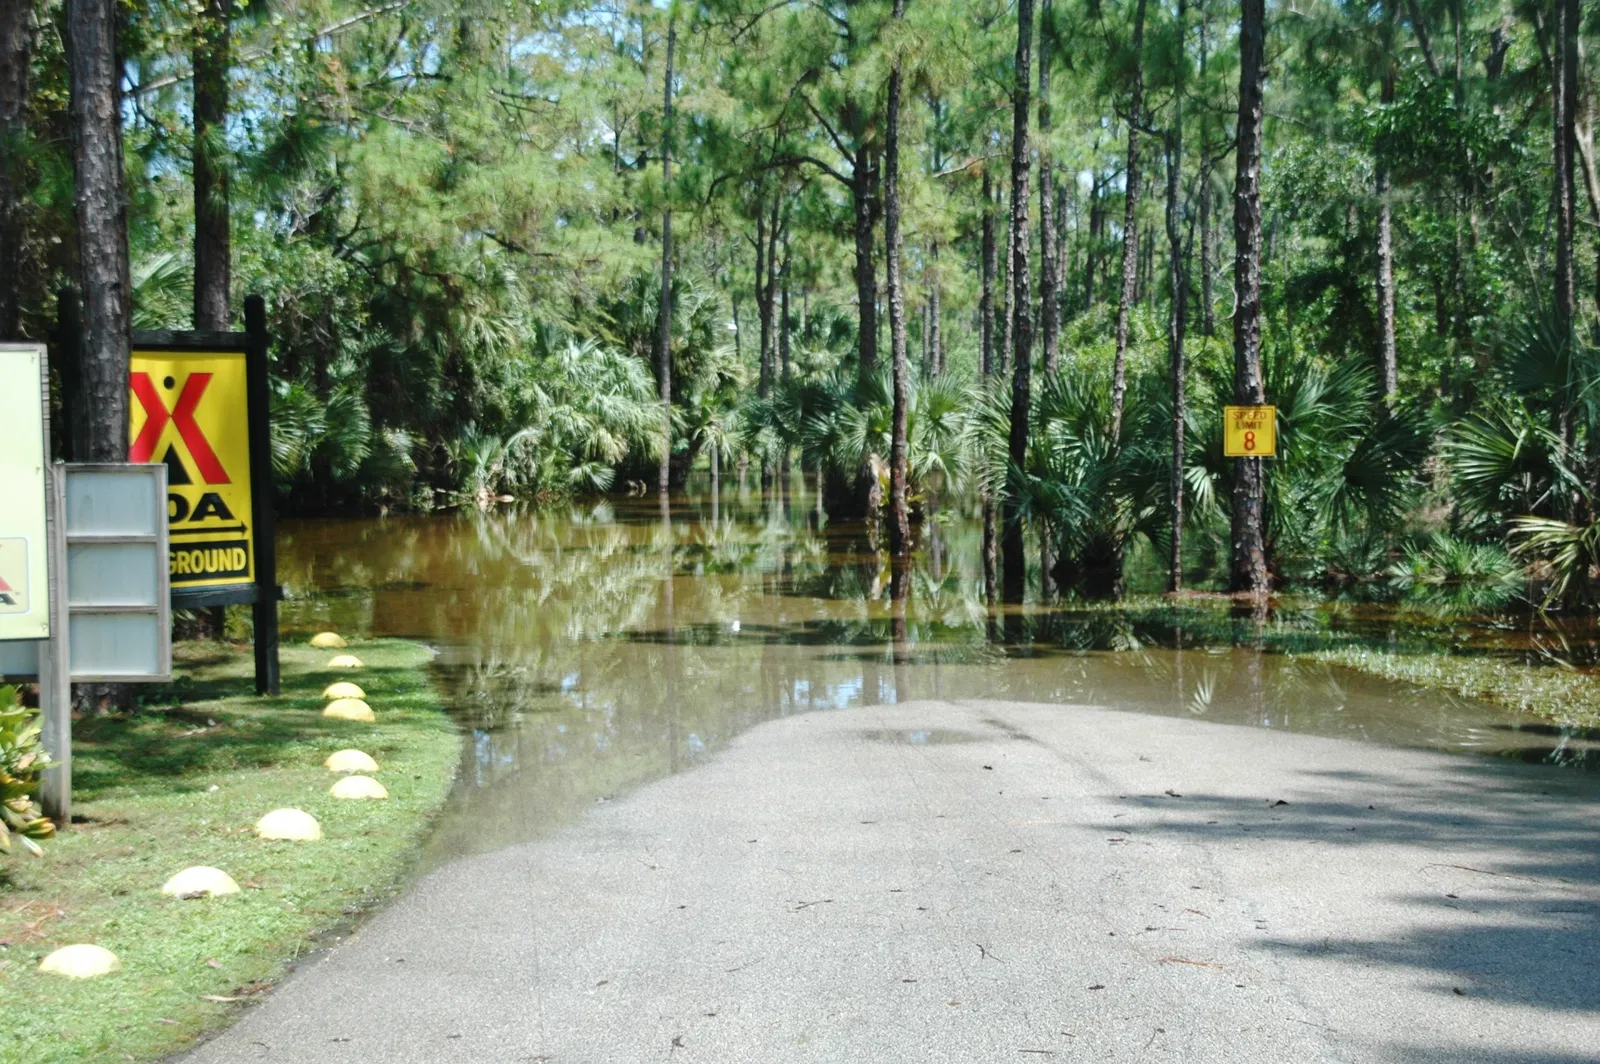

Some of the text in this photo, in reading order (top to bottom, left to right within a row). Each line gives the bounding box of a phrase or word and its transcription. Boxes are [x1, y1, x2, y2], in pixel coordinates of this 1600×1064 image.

[1233, 411, 1267, 420] SPEED
[1235, 421, 1263, 430] LIMIT
[1244, 431, 1256, 451] 8
